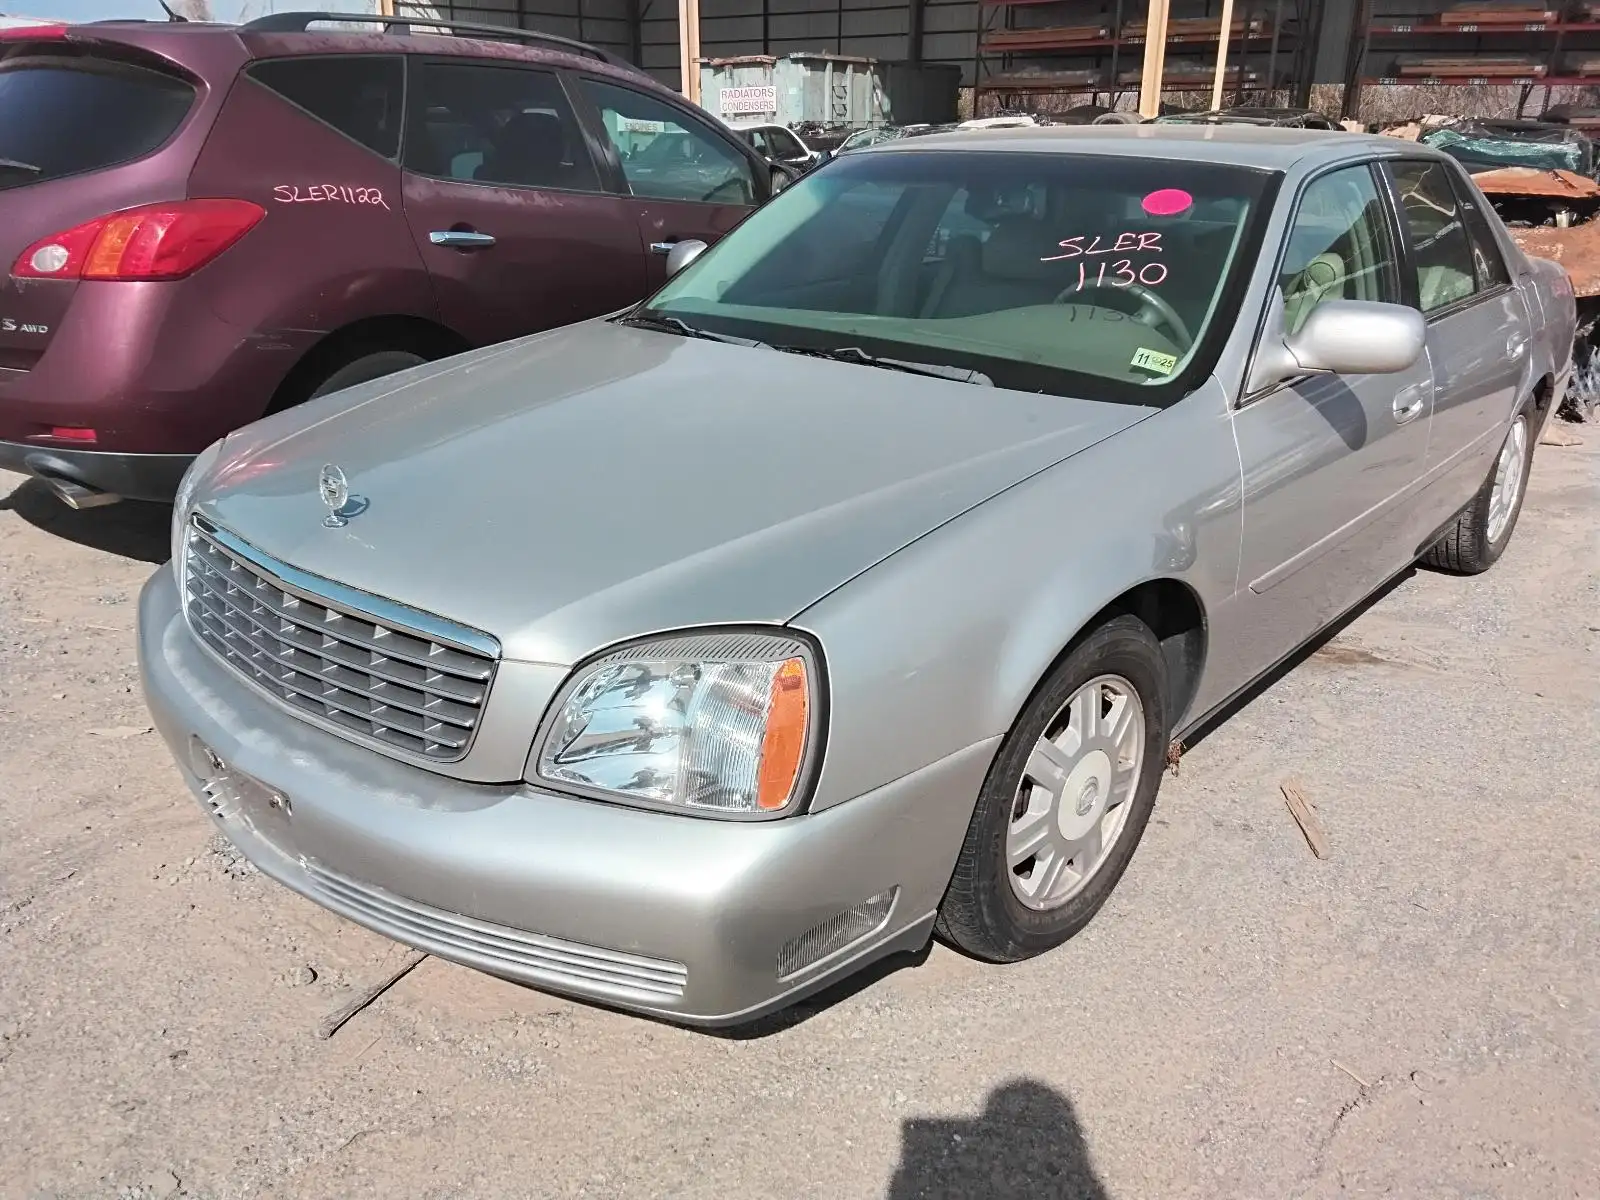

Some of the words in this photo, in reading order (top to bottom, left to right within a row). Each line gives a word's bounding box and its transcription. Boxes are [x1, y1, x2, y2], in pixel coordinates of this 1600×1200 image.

[721, 88, 774, 99] RADIATORS
[722, 100, 774, 111] CONDENSERS
[1040, 232, 1163, 261] SLER
[1075, 259, 1168, 292] 1130
[2, 318, 17, 331] S
[20, 324, 49, 333] AWD
[1137, 353, 1150, 365] 11
[1159, 358, 1174, 368] 25
